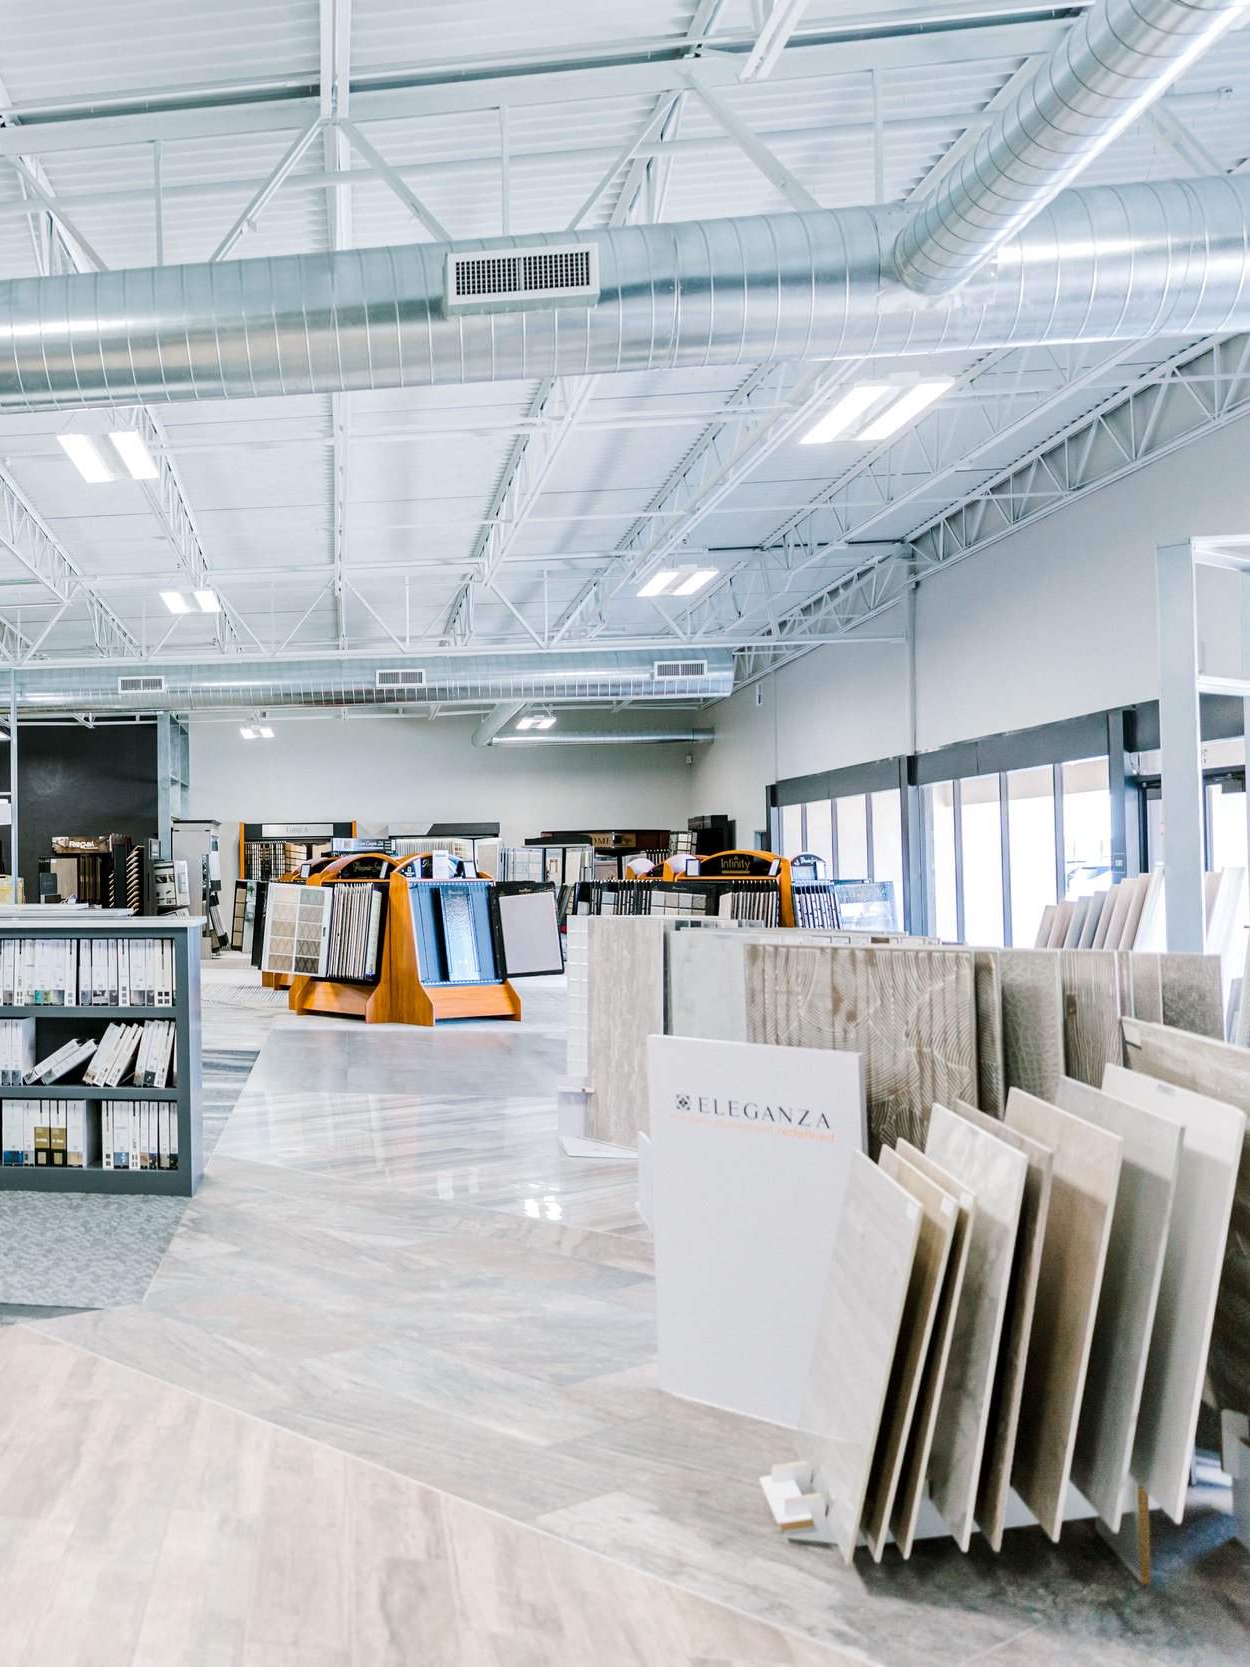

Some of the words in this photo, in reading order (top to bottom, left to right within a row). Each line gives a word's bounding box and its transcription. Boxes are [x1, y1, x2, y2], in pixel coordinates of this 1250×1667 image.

[69, 840, 95, 849] Regal
[721, 858, 750, 871] Infinity
[698, 1096, 831, 1129] ELEGANZA
[778, 1127, 836, 1143] redefined
